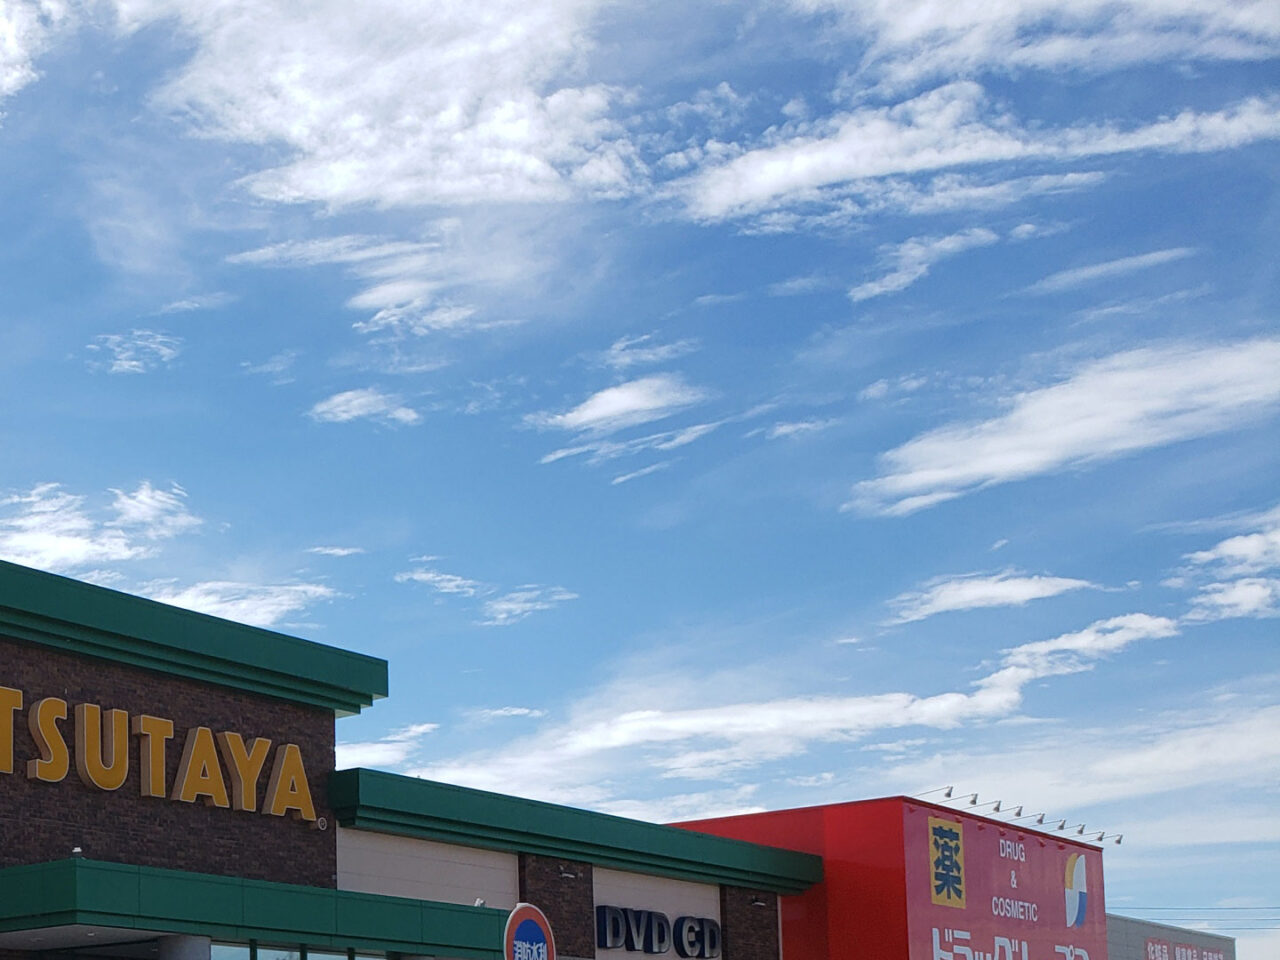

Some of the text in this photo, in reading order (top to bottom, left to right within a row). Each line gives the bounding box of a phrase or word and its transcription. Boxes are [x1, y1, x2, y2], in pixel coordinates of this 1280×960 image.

[931, 825, 963, 900] 薬
[999, 838, 1026, 863] DRUG
[1010, 869, 1018, 889] &
[991, 895, 1038, 922] COSMETIC
[596, 904, 722, 959] DVD CD
